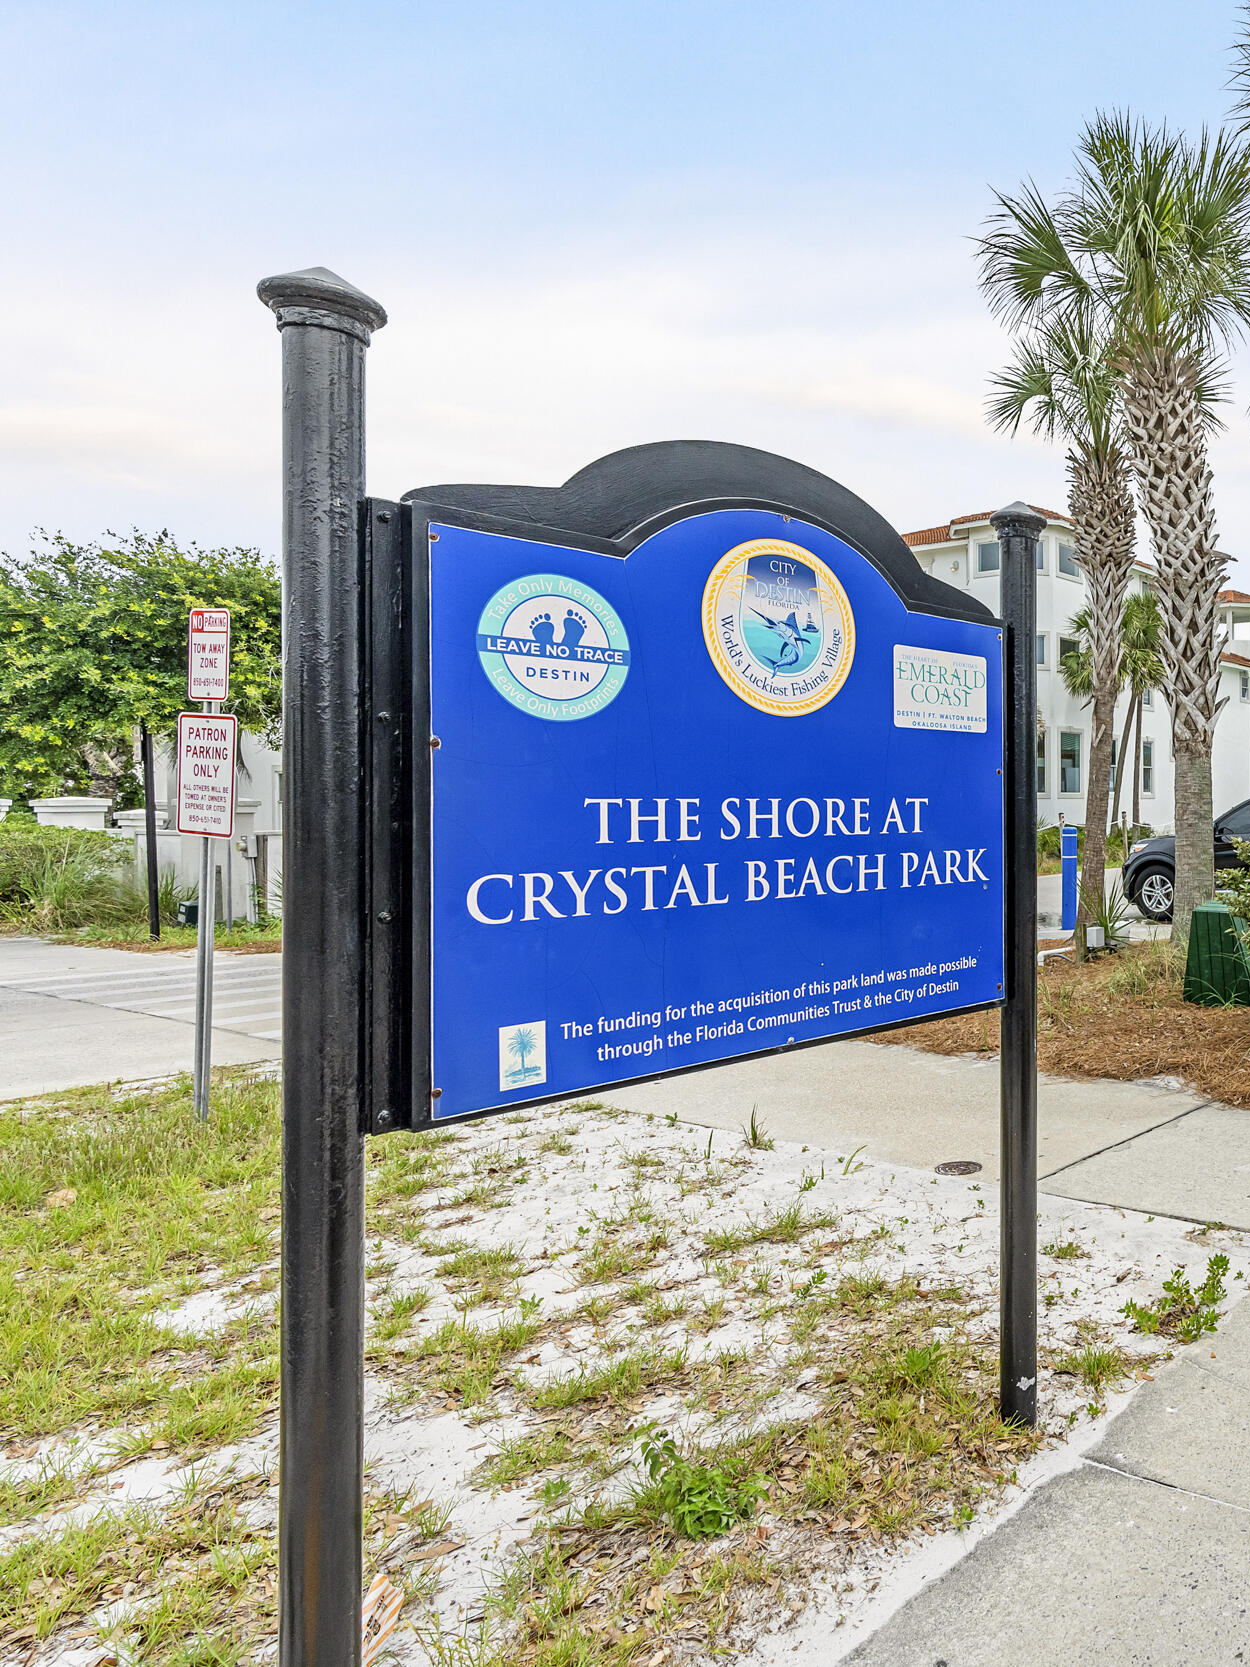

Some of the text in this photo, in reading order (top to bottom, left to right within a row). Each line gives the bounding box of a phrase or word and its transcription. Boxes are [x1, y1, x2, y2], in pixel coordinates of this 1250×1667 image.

[769, 560, 797, 576] CITY
[776, 576, 790, 587] OF
[755, 581, 812, 607] DESTIN
[488, 578, 620, 636] Take Only Memories
[768, 600, 800, 611] FLORIDA
[193, 614, 226, 630] NO PARKING
[193, 643, 225, 654] TOW AWAY
[487, 637, 624, 664] LEAVE NO TRACE
[721, 614, 843, 697] World's Luckiest Fishing Village
[200, 657, 218, 669] ZONE
[526, 666, 590, 682] DESTIN
[896, 661, 986, 690] EMERALD
[492, 668, 619, 718] Leave Only Footprints
[911, 683, 972, 707] COAST
[896, 710, 921, 718] DESTIN
[940, 713, 965, 721] WALTON
[966, 715, 986, 723] BEACH
[912, 721, 972, 731] OKALOOSA ISLAND
[188, 727, 227, 742] PATRON
[185, 745, 228, 761] PARKING
[193, 763, 220, 778] ONLY
[185, 793, 199, 801] TOWED
[193, 784, 210, 792] OTHERS
[223, 786, 229, 794] BE
[185, 802, 204, 810] EXPENSE
[584, 798, 929, 844] THE SHORE AT
[466, 848, 990, 925] CRYSTAL BEACH PARK
[560, 955, 977, 1040] The funding for the acquisition of this park land was made possible
[597, 980, 959, 1061] through the Florida Communities Trust & the City of Destin
